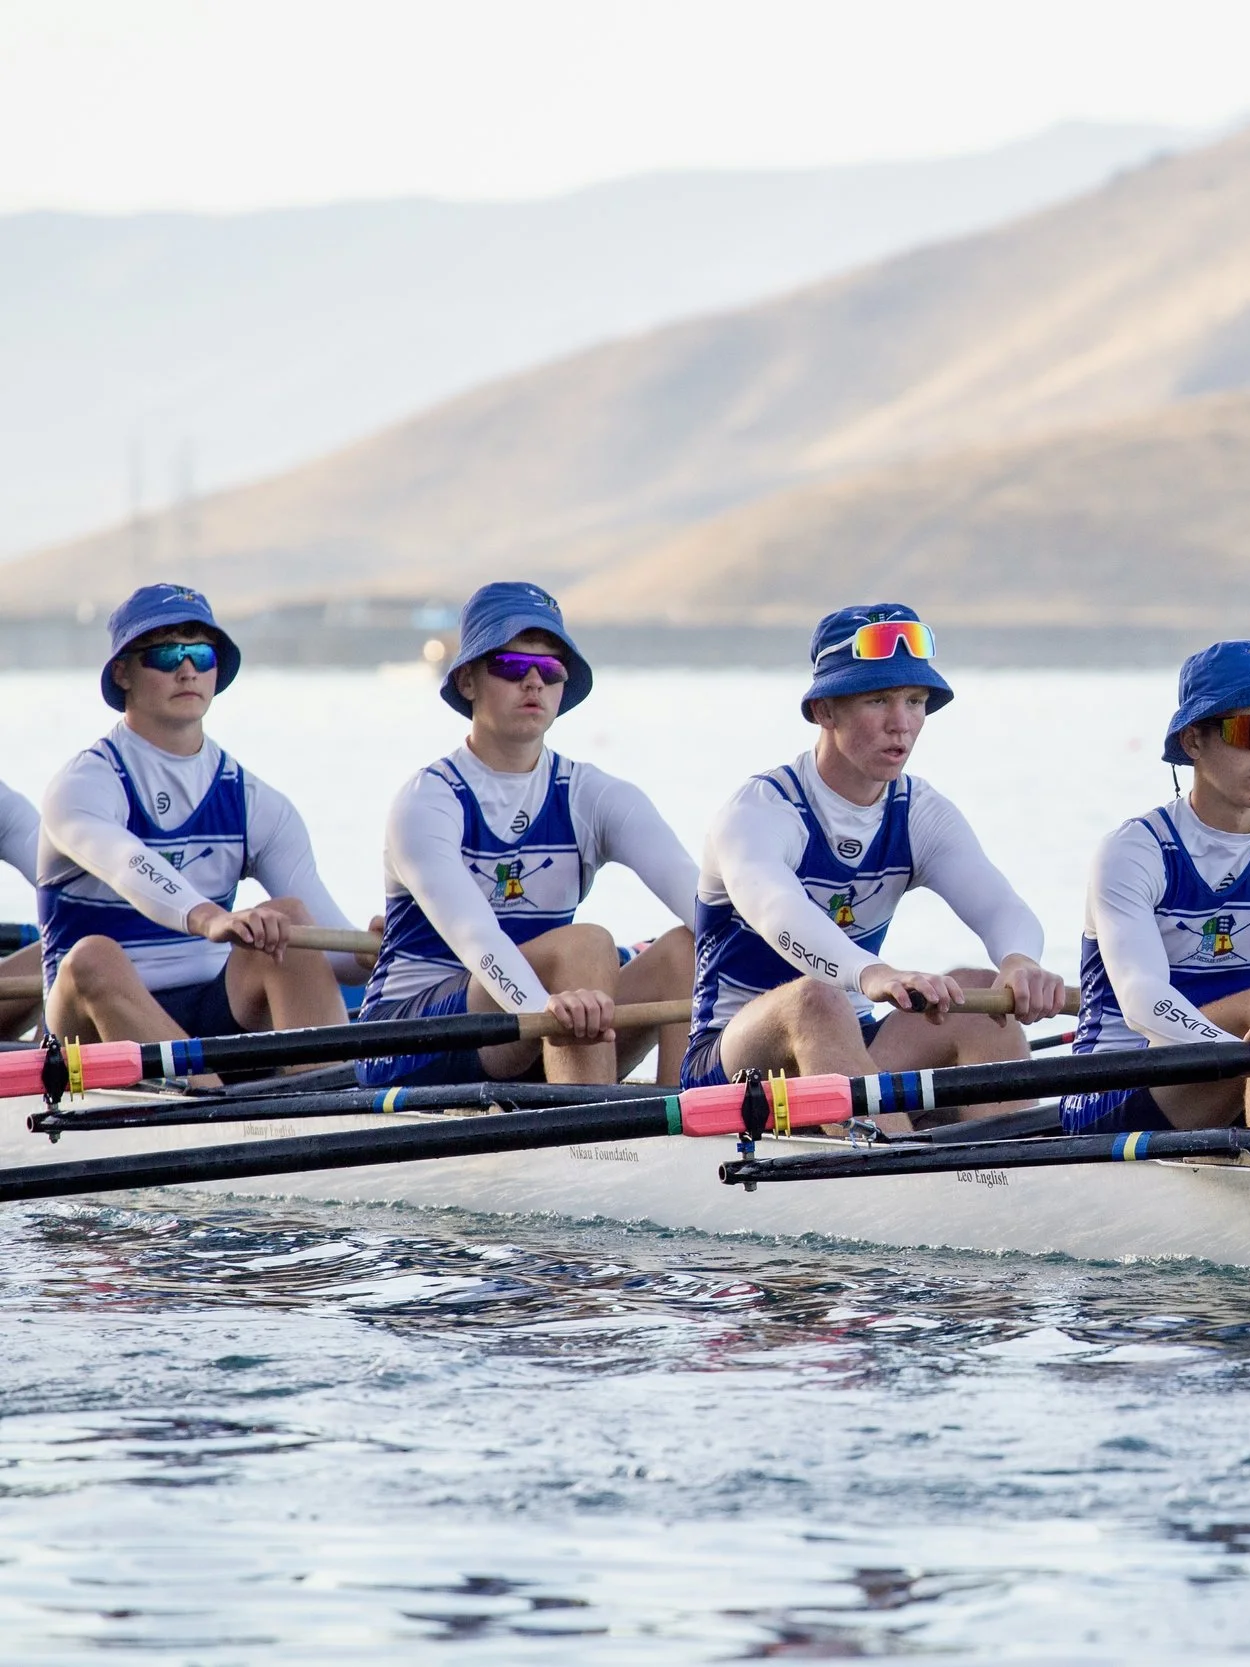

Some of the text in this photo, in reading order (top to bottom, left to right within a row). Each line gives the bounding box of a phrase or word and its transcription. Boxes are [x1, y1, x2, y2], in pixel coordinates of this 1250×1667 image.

[569, 1146, 639, 1162] Nikau Foundation
[957, 1169, 1009, 1189] Leo English
